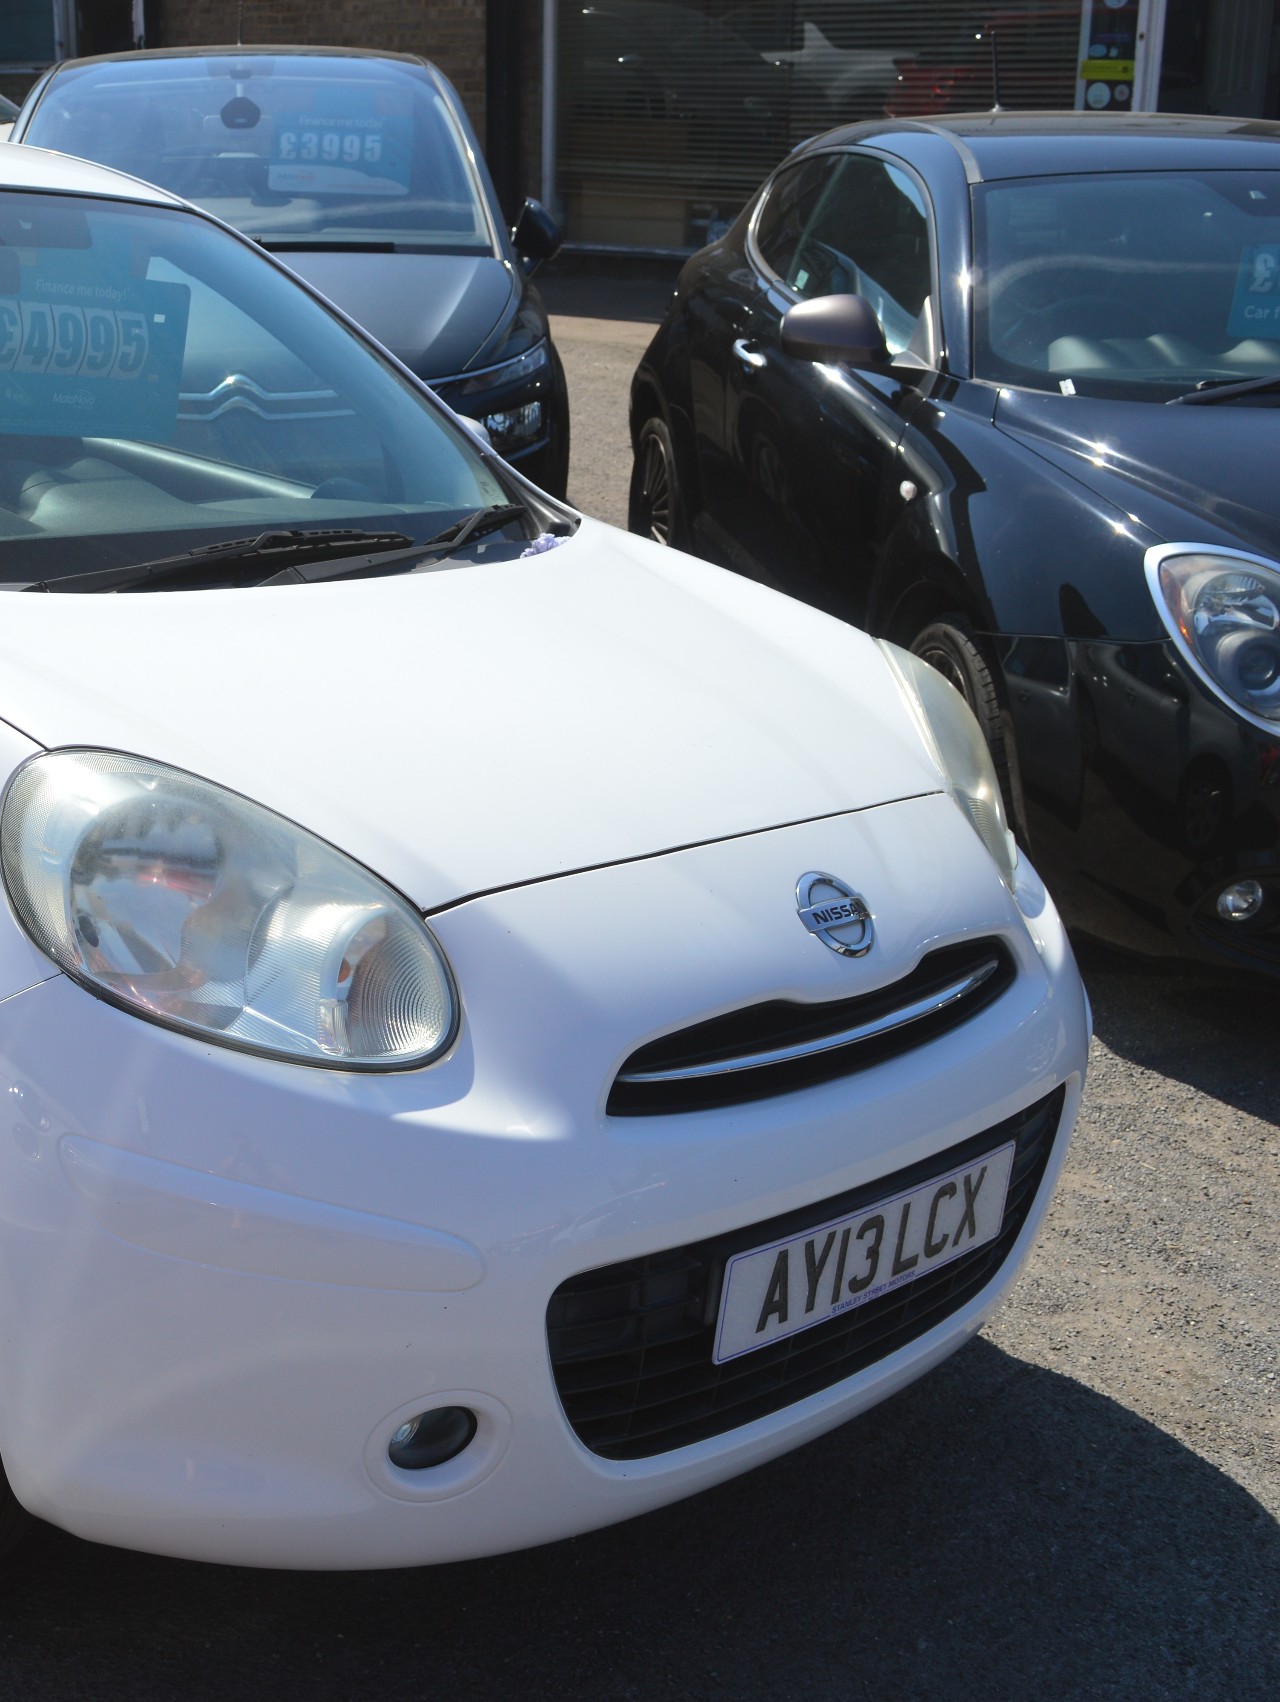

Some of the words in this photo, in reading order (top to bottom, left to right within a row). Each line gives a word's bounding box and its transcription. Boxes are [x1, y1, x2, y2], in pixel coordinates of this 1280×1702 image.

[279, 132, 382, 162] £3995
[35, 279, 75, 297] Finance
[77, 285, 94, 297] me
[1244, 305, 1270, 319] Car
[811, 902, 866, 925] NISSA
[755, 1214, 885, 1334] AY13
[891, 1165, 988, 1277] LCX
[831, 1294, 862, 1314] STANLEY
[862, 1282, 889, 1301] STREET
[888, 1270, 916, 1289] MOTORS
